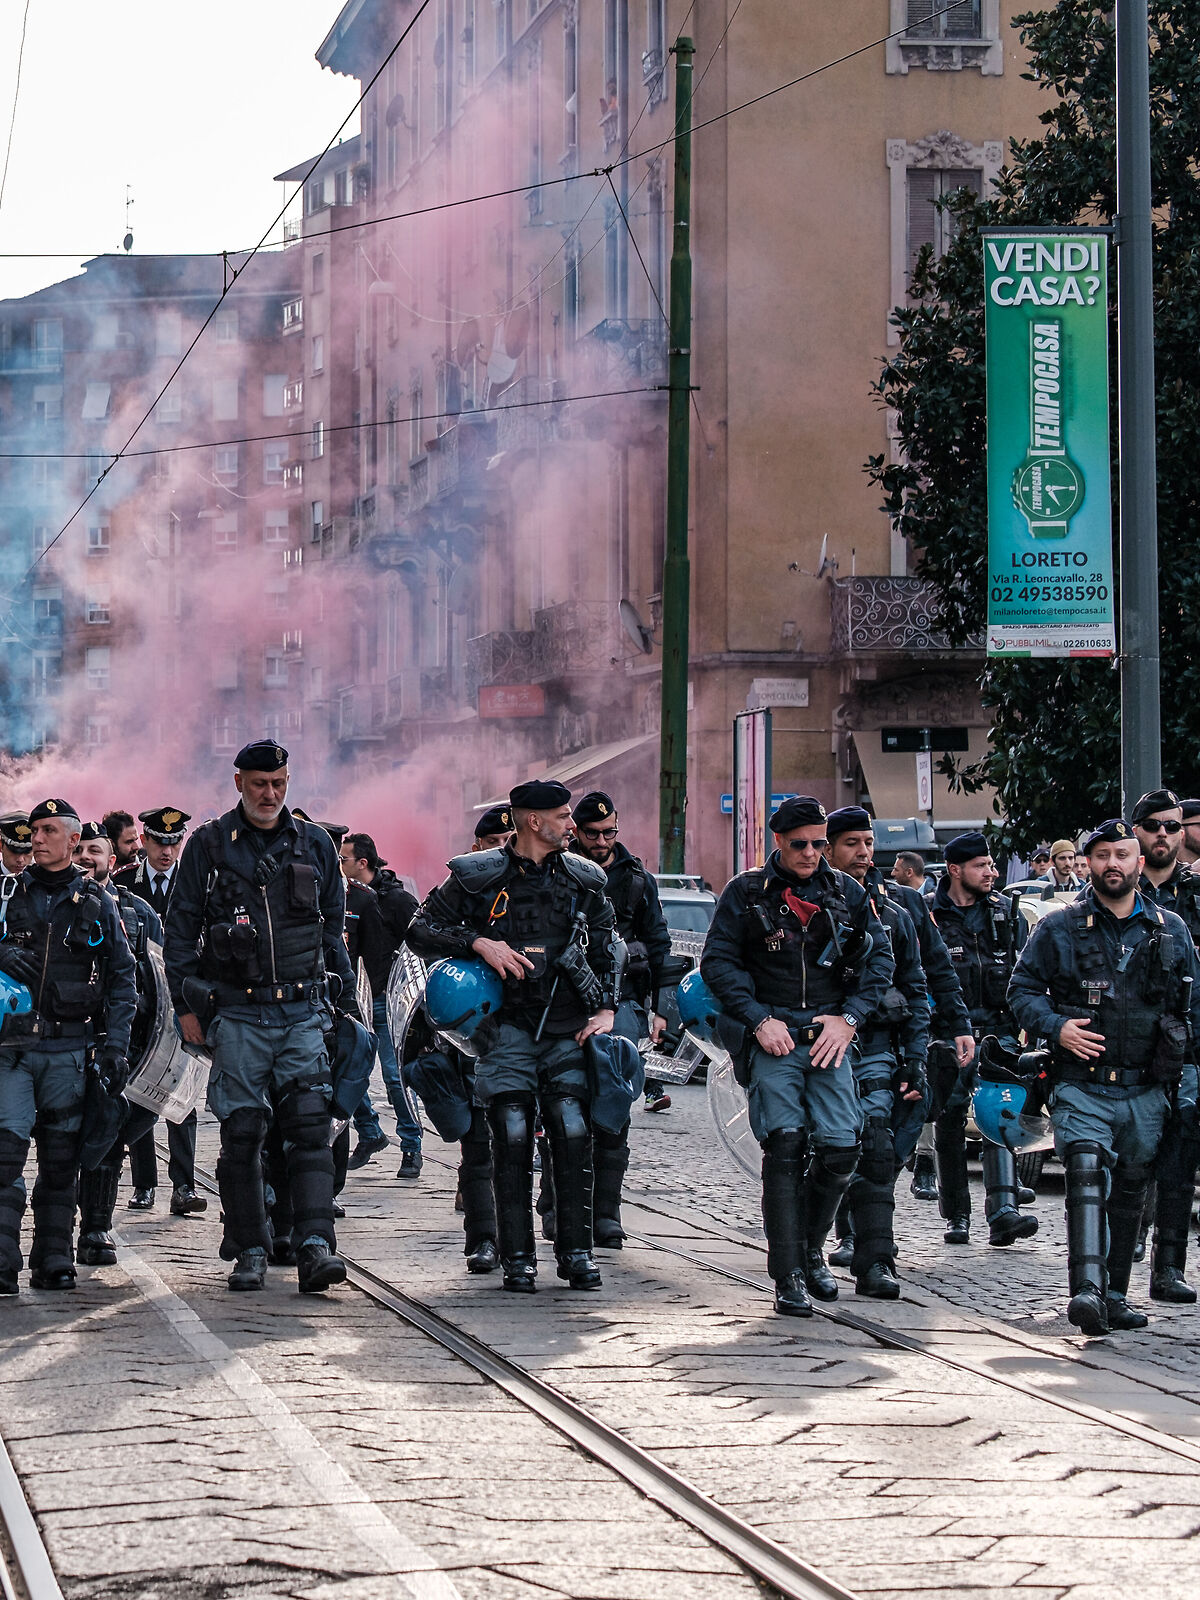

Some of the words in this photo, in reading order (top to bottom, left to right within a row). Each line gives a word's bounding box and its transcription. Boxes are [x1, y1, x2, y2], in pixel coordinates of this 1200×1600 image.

[987, 242, 1099, 272] VENDI
[990, 276, 1100, 306] CASA?
[1033, 324, 1060, 447] TEMPOCASA
[1032, 466, 1042, 510] TEMPOCASA
[1011, 552, 1088, 568] LORETO
[993, 575, 1009, 584] Via
[1012, 575, 1022, 583] R.
[1025, 573, 1087, 584] Leoncavallo,
[1090, 573, 1103, 582] 28
[991, 587, 1014, 602] 02
[1018, 586, 1108, 602] 49538590
[993, 607, 1107, 617] milanoloreto@tempocasa.it
